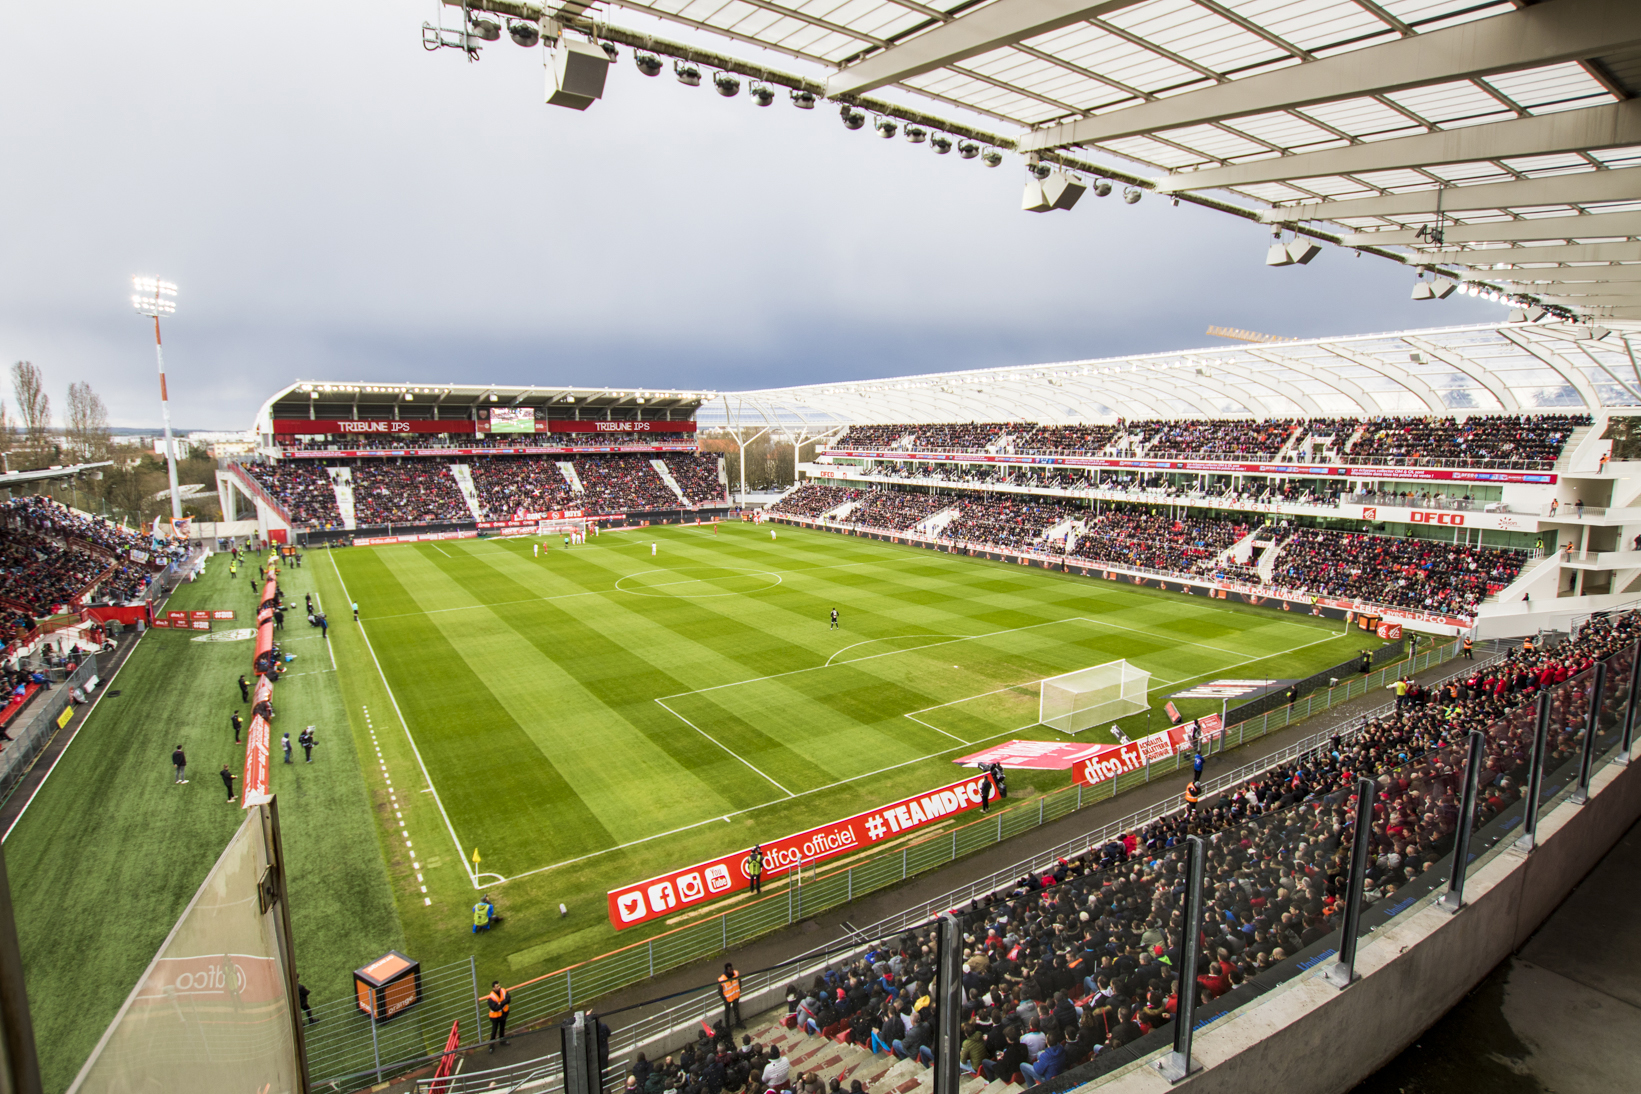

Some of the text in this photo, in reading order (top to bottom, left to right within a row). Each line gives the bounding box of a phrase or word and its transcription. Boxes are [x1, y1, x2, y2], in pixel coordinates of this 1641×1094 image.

[337, 421, 410, 432] TRIBUNE IPS
[595, 421, 651, 431] TRIBUNE IPS
[1063, 489, 1115, 500] TRIBUNE
[1125, 494, 1177, 505] CAISSE
[1410, 511, 1465, 526] DFCO
[1230, 583, 1251, 593] UNIS
[1252, 587, 1275, 598] POUR
[1352, 603, 1446, 625] CEBFC avec le DFCO
[1084, 747, 1140, 784] dfco.fr
[803, 825, 856, 855] officiel
[710, 868, 722, 878] You
[711, 876, 728, 889] Tube
[388, 996, 414, 1014] orange
